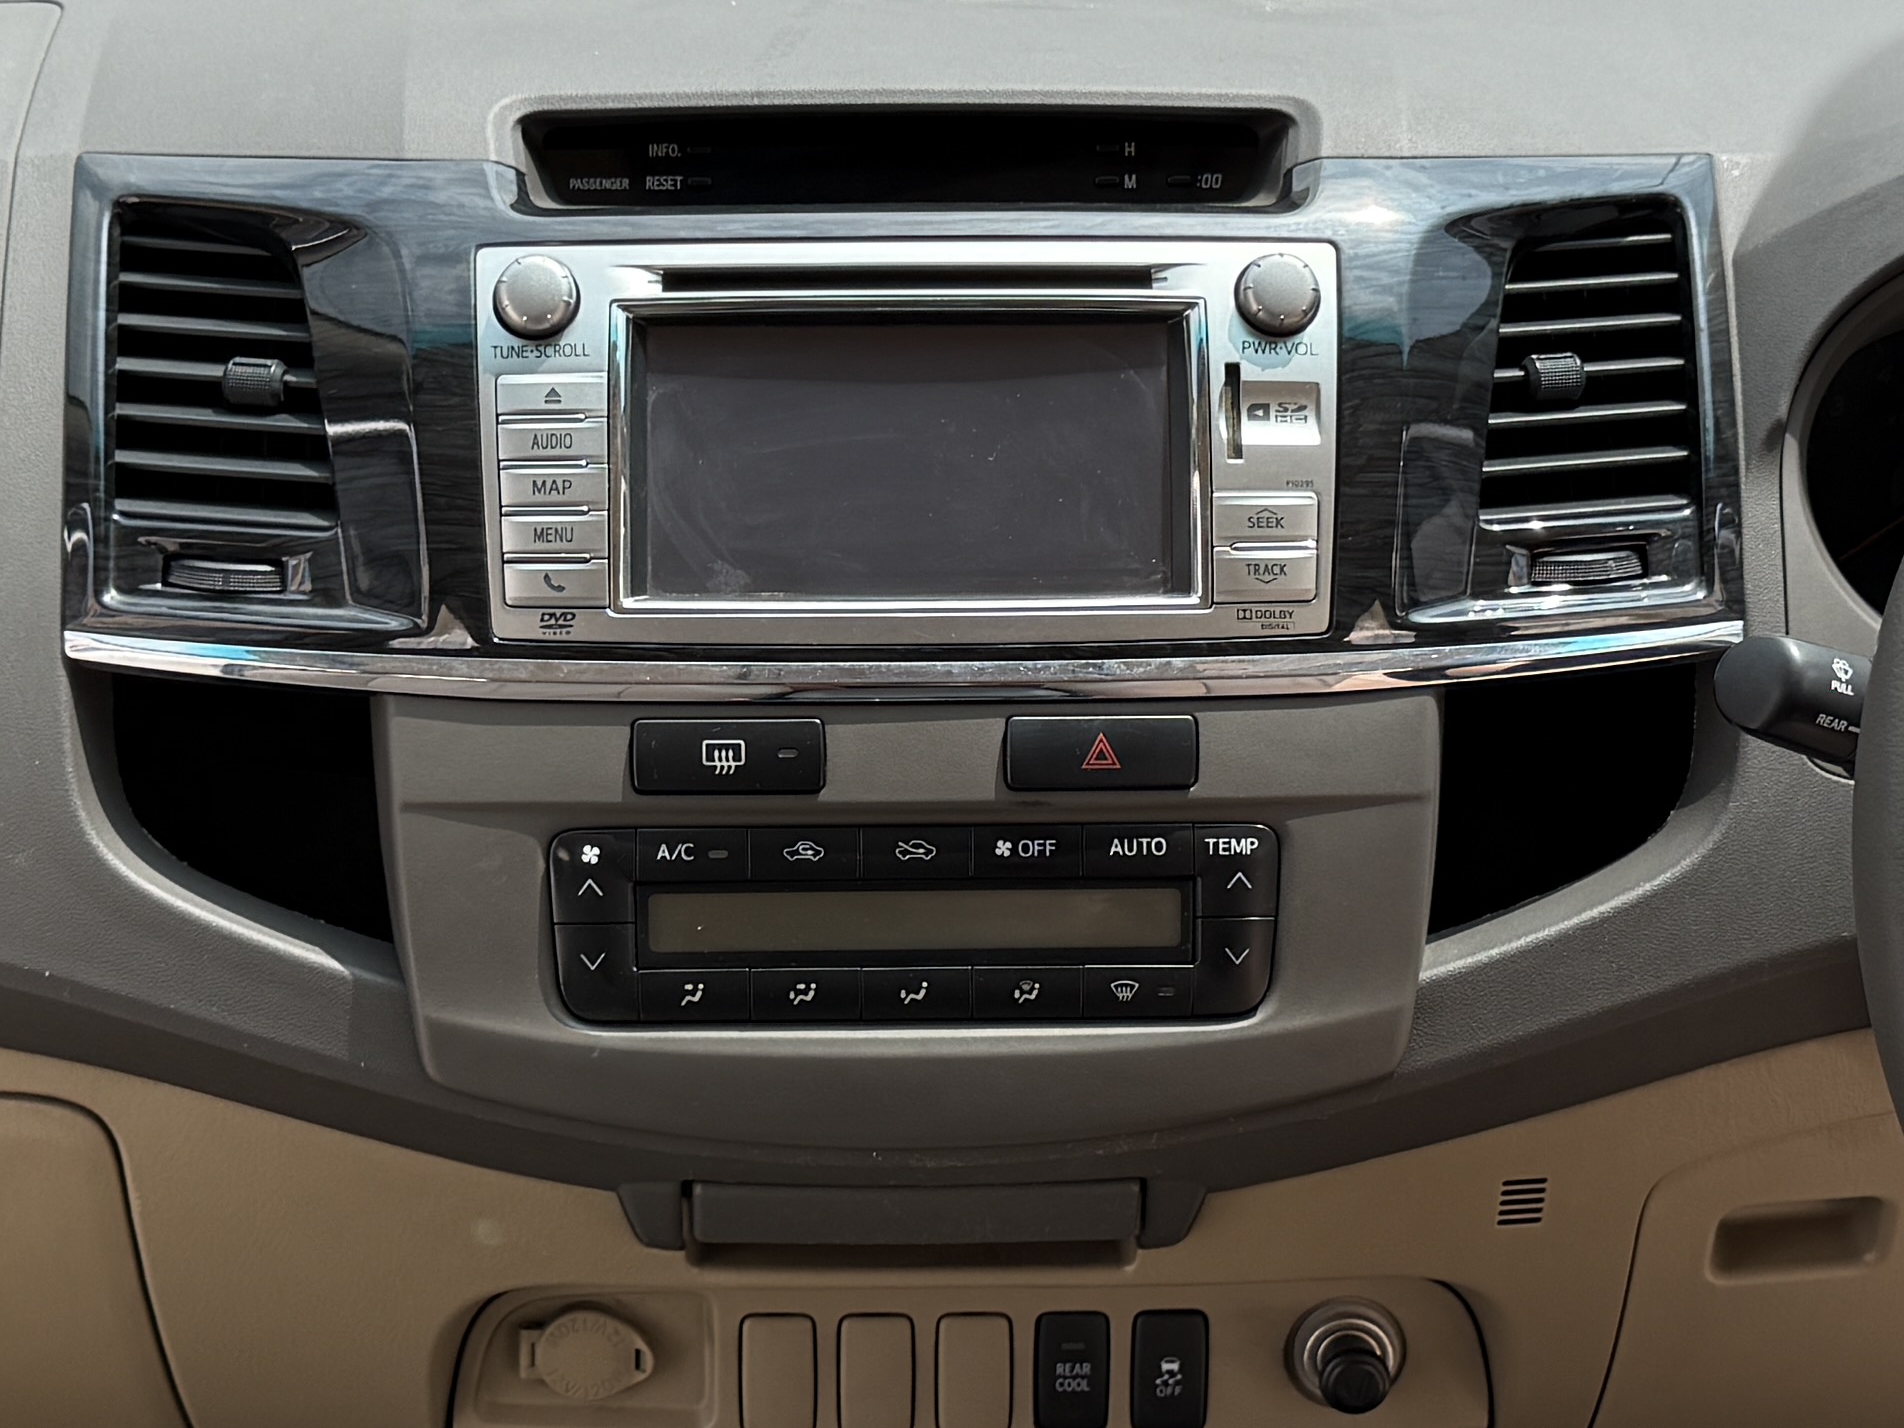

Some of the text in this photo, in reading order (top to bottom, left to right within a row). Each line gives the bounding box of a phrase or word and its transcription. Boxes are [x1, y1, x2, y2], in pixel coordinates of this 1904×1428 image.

[648, 143, 682, 158] INFO.
[1124, 142, 1135, 157] H
[646, 176, 683, 190] RESET
[1124, 174, 1137, 189] M
[531, 433, 573, 450] AUDIO
[532, 479, 572, 496] MAP
[1247, 516, 1285, 530] SEEK
[533, 527, 574, 544] MENU
[1246, 563, 1287, 576] TRACK
[539, 612, 577, 624] DVD
[1255, 609, 1295, 621] DOLBY
[1830, 679, 1854, 696] PULL
[1815, 713, 1848, 733] REAR
[656, 842, 695, 863] A/C
[1018, 838, 1056, 859] OFF
[1109, 836, 1167, 858] AUTO
[1205, 836, 1259, 856] TEMP
[1055, 1362, 1091, 1376] REAR
[1055, 1378, 1091, 1392] COOL
[1156, 1385, 1183, 1397] OFF
